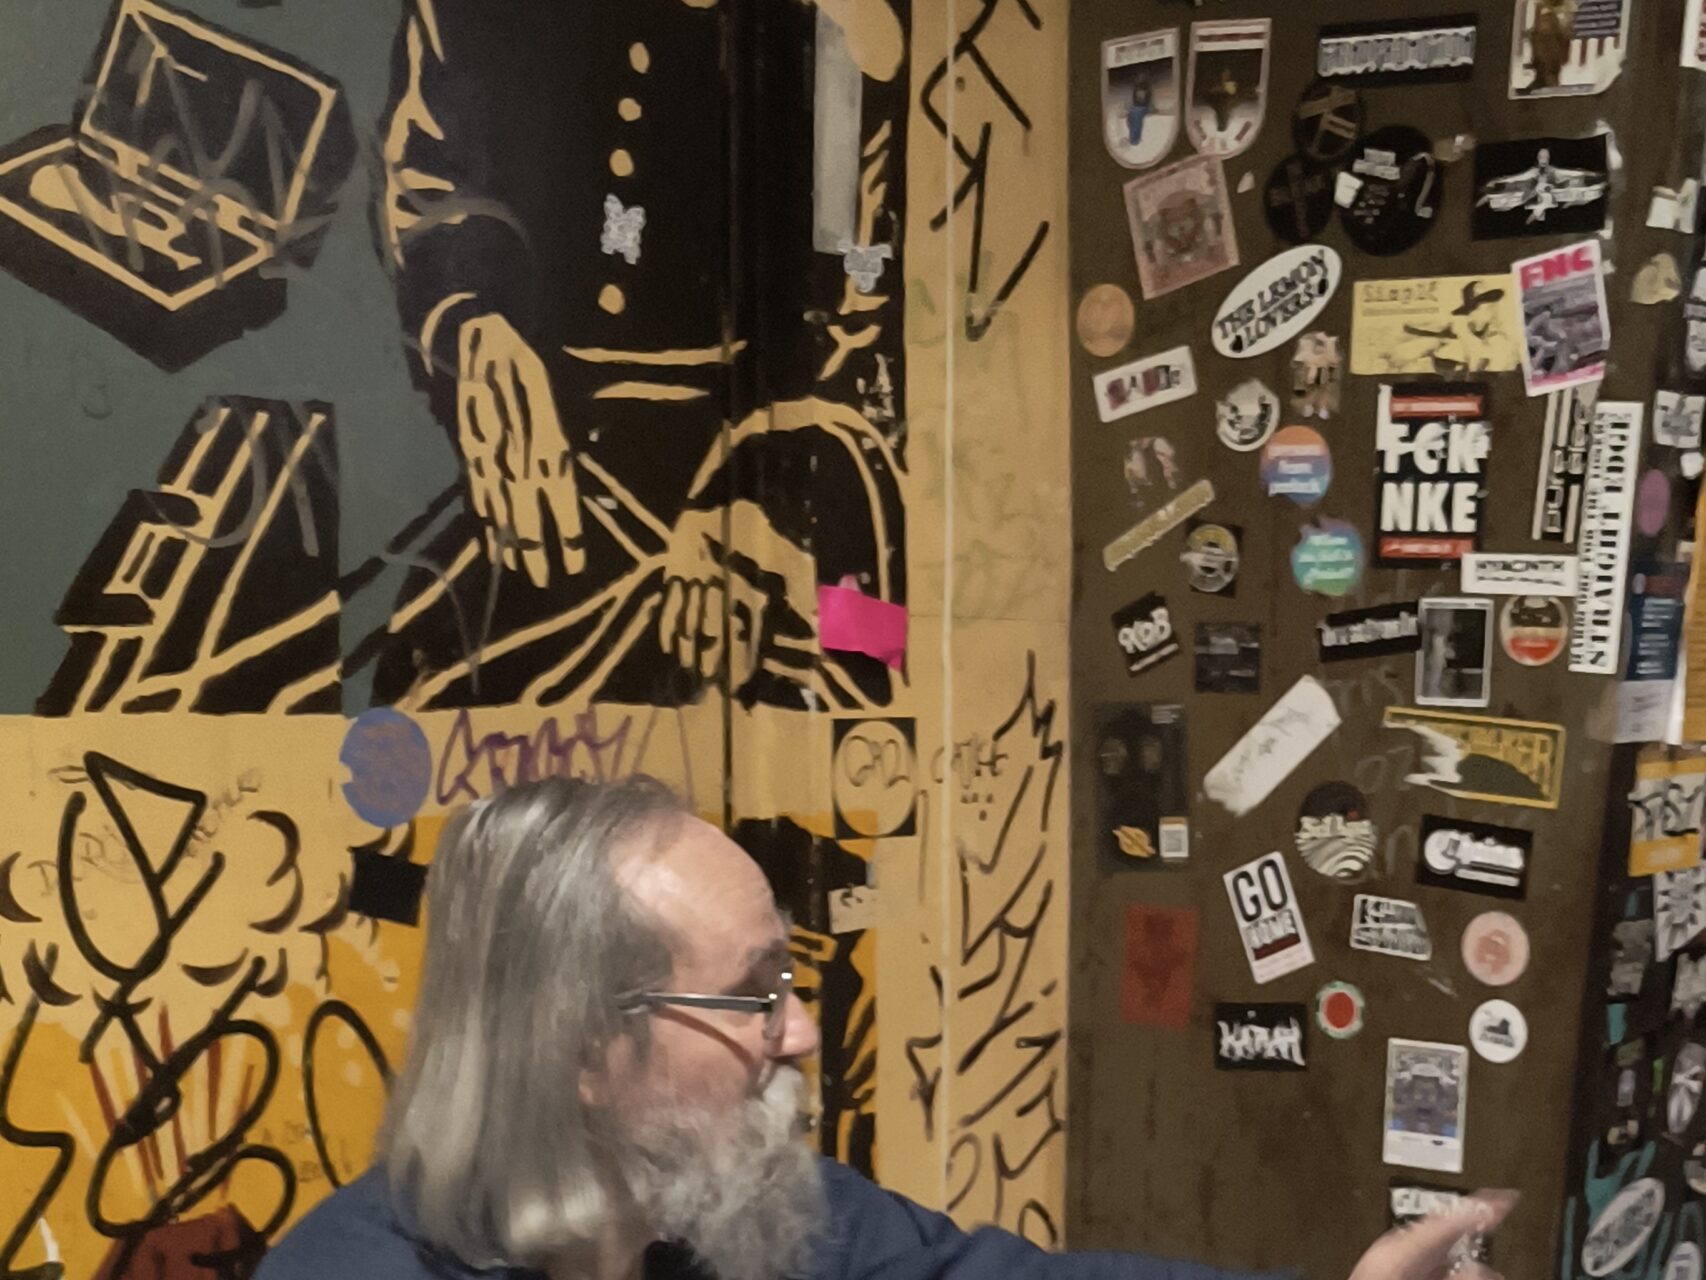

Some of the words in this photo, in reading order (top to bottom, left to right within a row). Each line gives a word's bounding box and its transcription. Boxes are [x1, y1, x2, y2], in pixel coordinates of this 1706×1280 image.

[1217, 299, 1256, 339] THE
[1603, 412, 1632, 495] EDGE
[1380, 481, 1479, 533] NKE
[1589, 509, 1621, 667] STRAIGHT
[1232, 858, 1288, 922] GO
